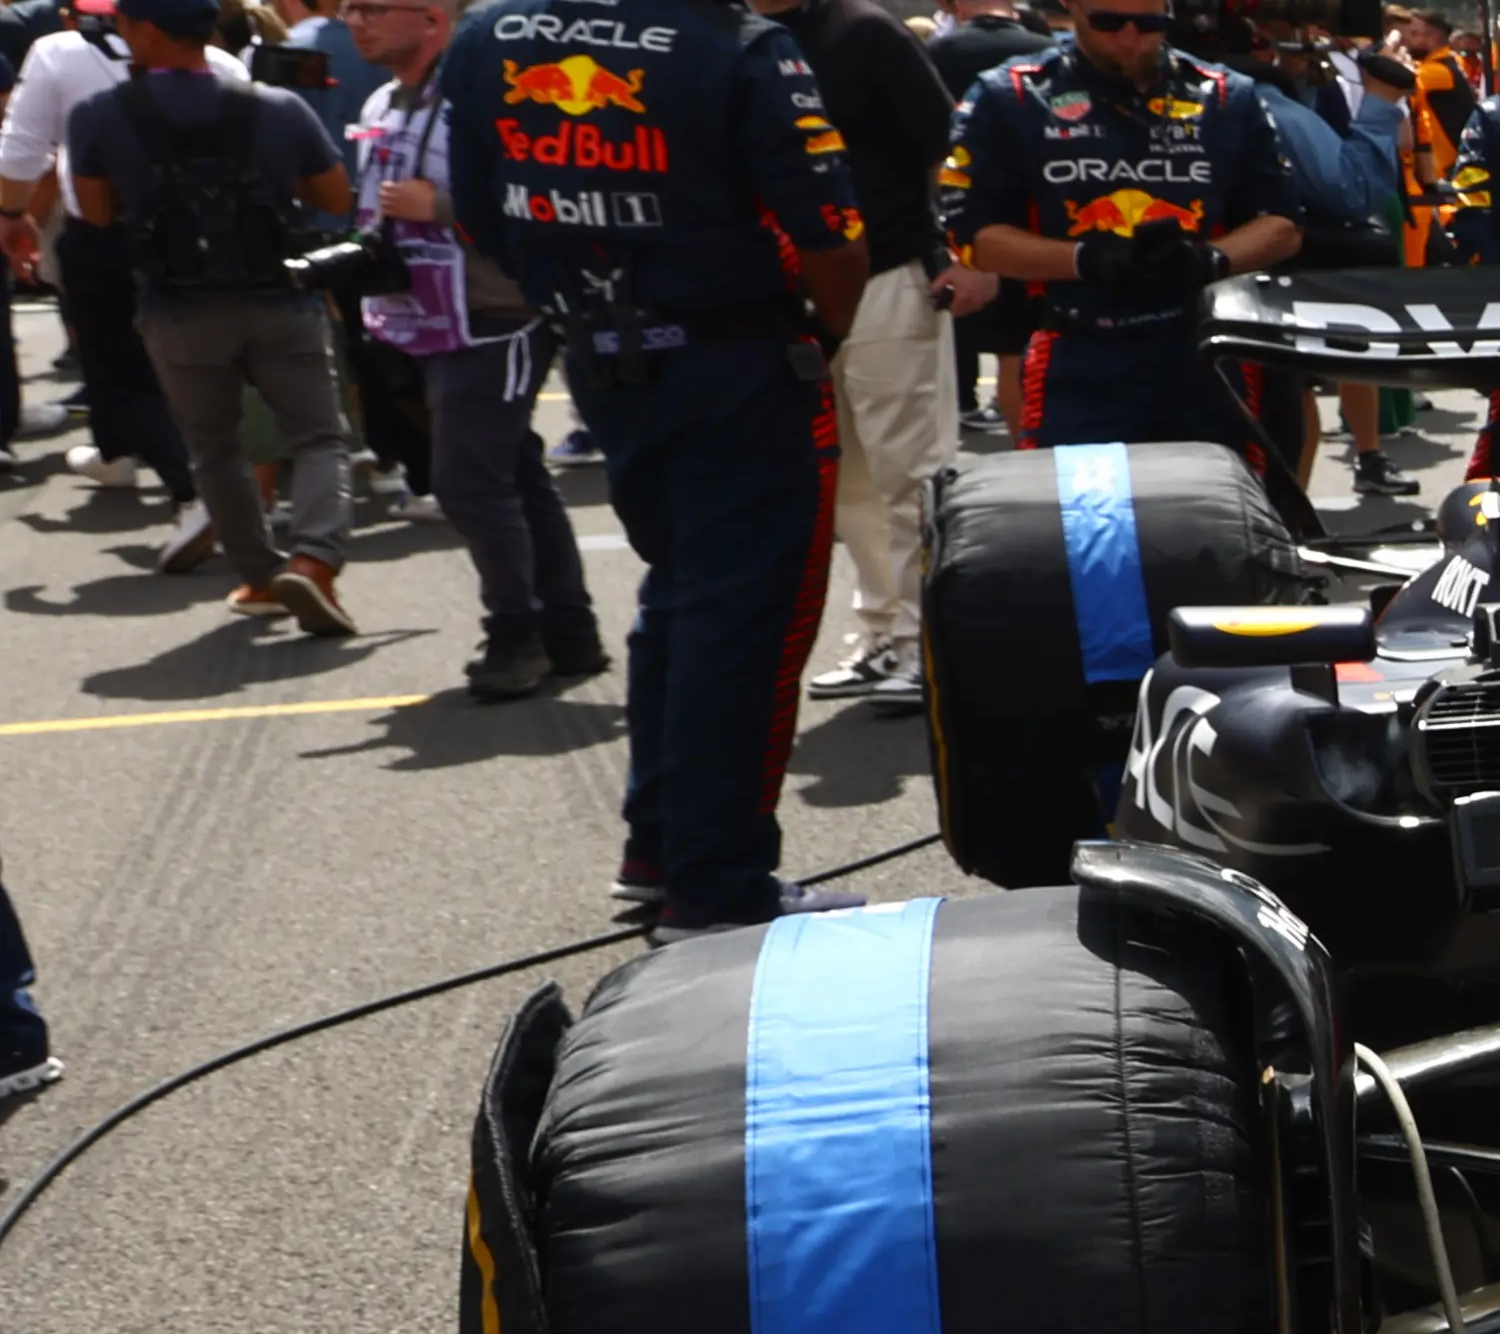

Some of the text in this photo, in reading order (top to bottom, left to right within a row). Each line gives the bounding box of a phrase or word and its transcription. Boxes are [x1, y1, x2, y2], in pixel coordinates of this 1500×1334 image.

[494, 14, 678, 53] ORACLE
[574, 123, 668, 173] Bull
[1043, 157, 1213, 185] ORACLE
[503, 182, 607, 227] Mobil
